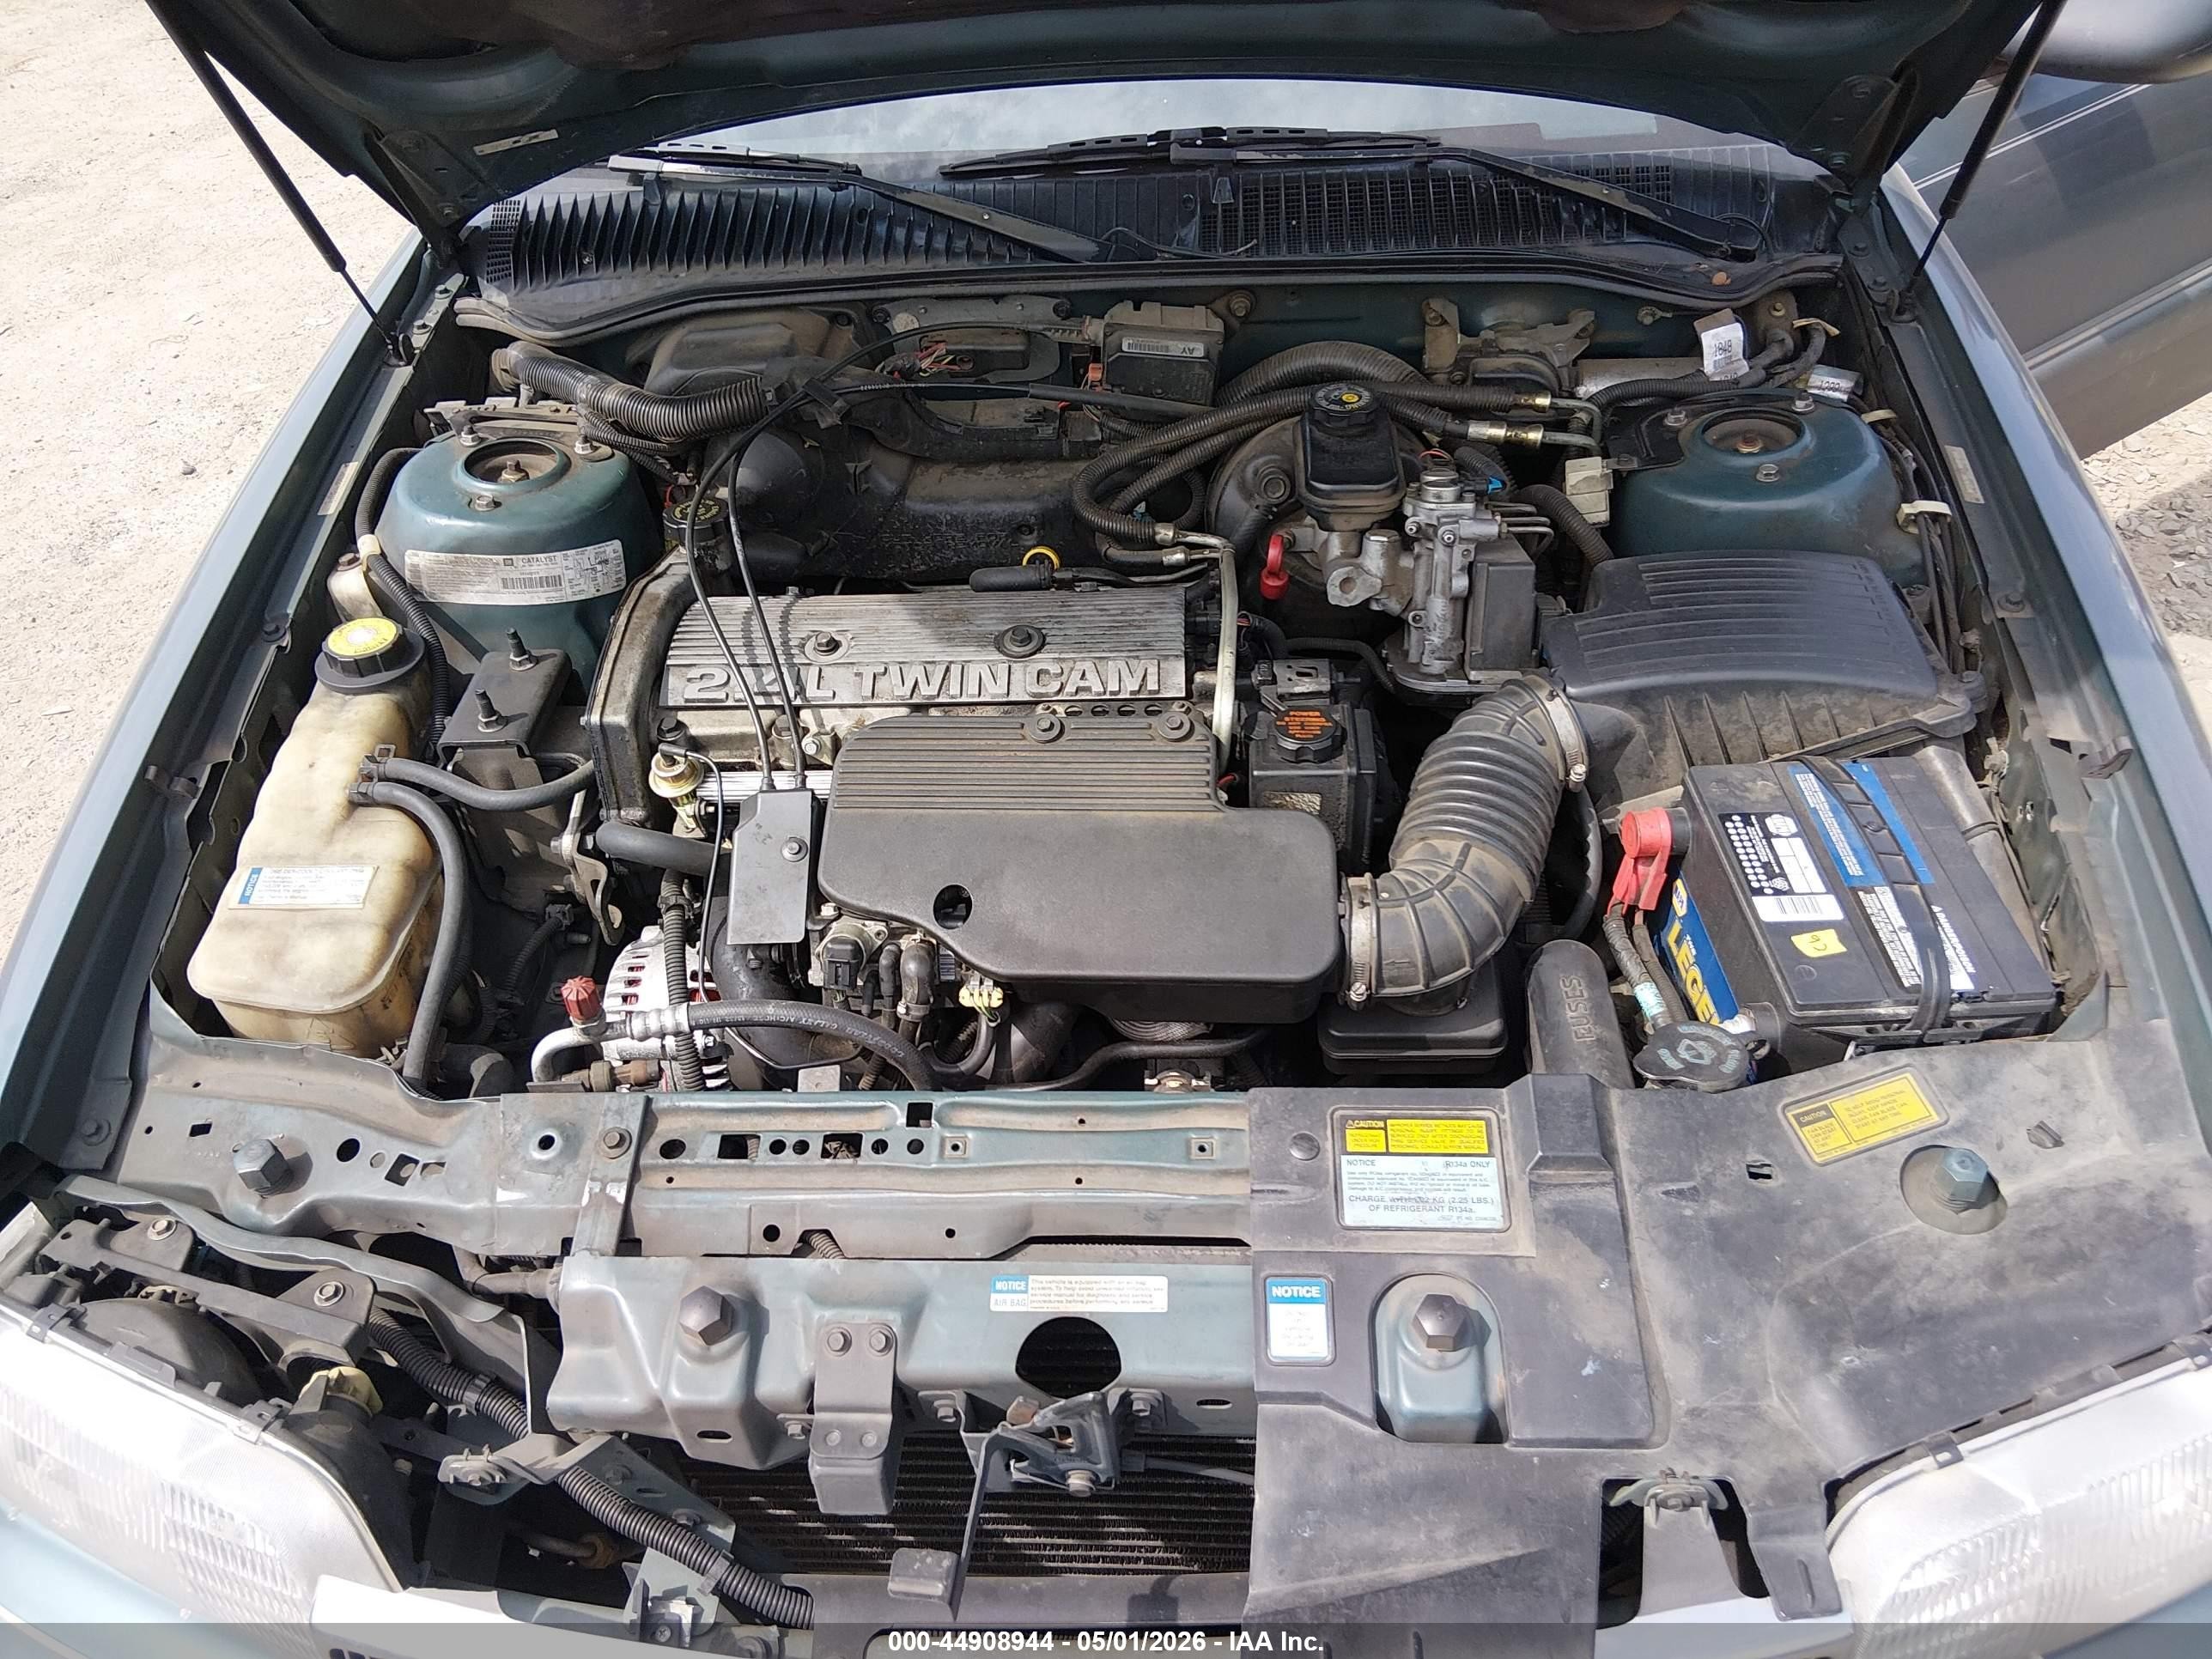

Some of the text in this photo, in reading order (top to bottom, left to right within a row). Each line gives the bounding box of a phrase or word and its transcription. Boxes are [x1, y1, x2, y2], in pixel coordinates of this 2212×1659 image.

[521, 555, 557, 564] CATALYST
[854, 662, 1011, 701] TWIN
[1024, 659, 1161, 698] CAM
[1559, 975, 1595, 1042] FUSES
[1800, 1110, 1827, 1122] CAUTION
[995, 1280, 1026, 1291] NOTICE
[1271, 1286, 1322, 1298] NOTICE
[994, 1297, 1026, 1306] AIR BAG
